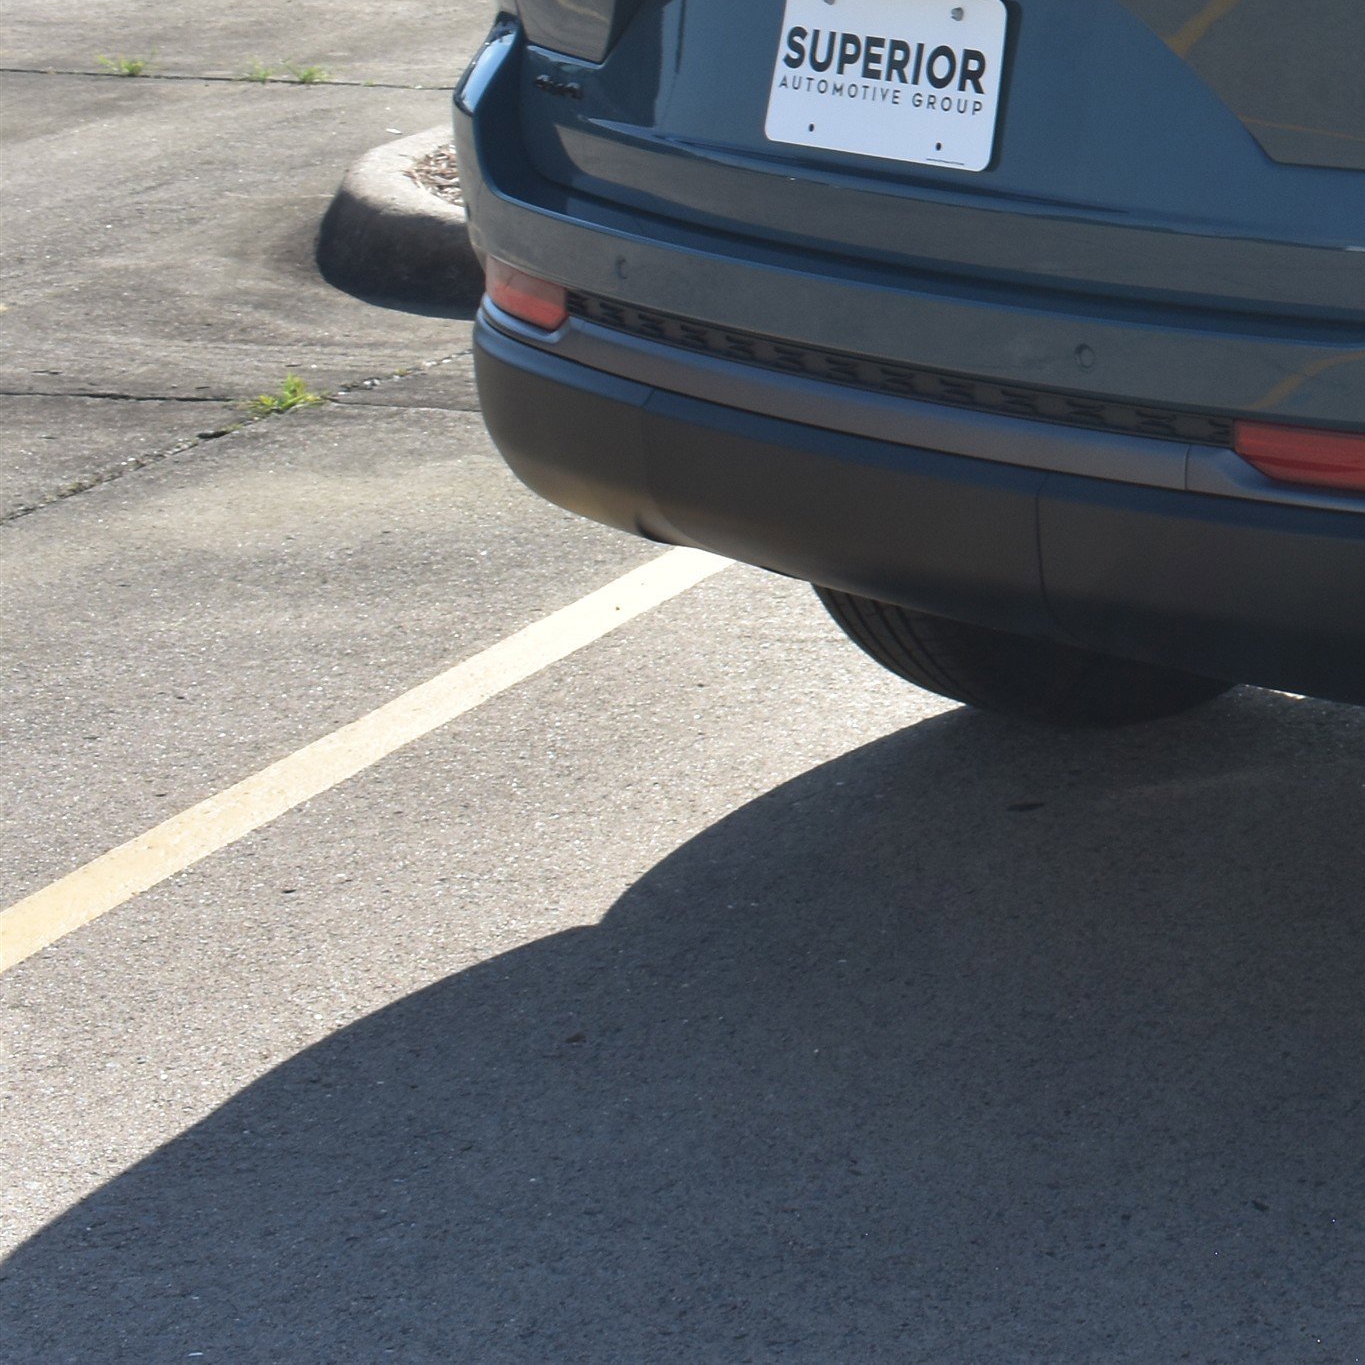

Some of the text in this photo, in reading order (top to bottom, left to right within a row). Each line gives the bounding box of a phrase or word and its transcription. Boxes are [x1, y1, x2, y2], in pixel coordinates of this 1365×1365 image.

[783, 25, 987, 95] SUPERIOR
[778, 74, 984, 117] AUTOMOTIVE GROUP
